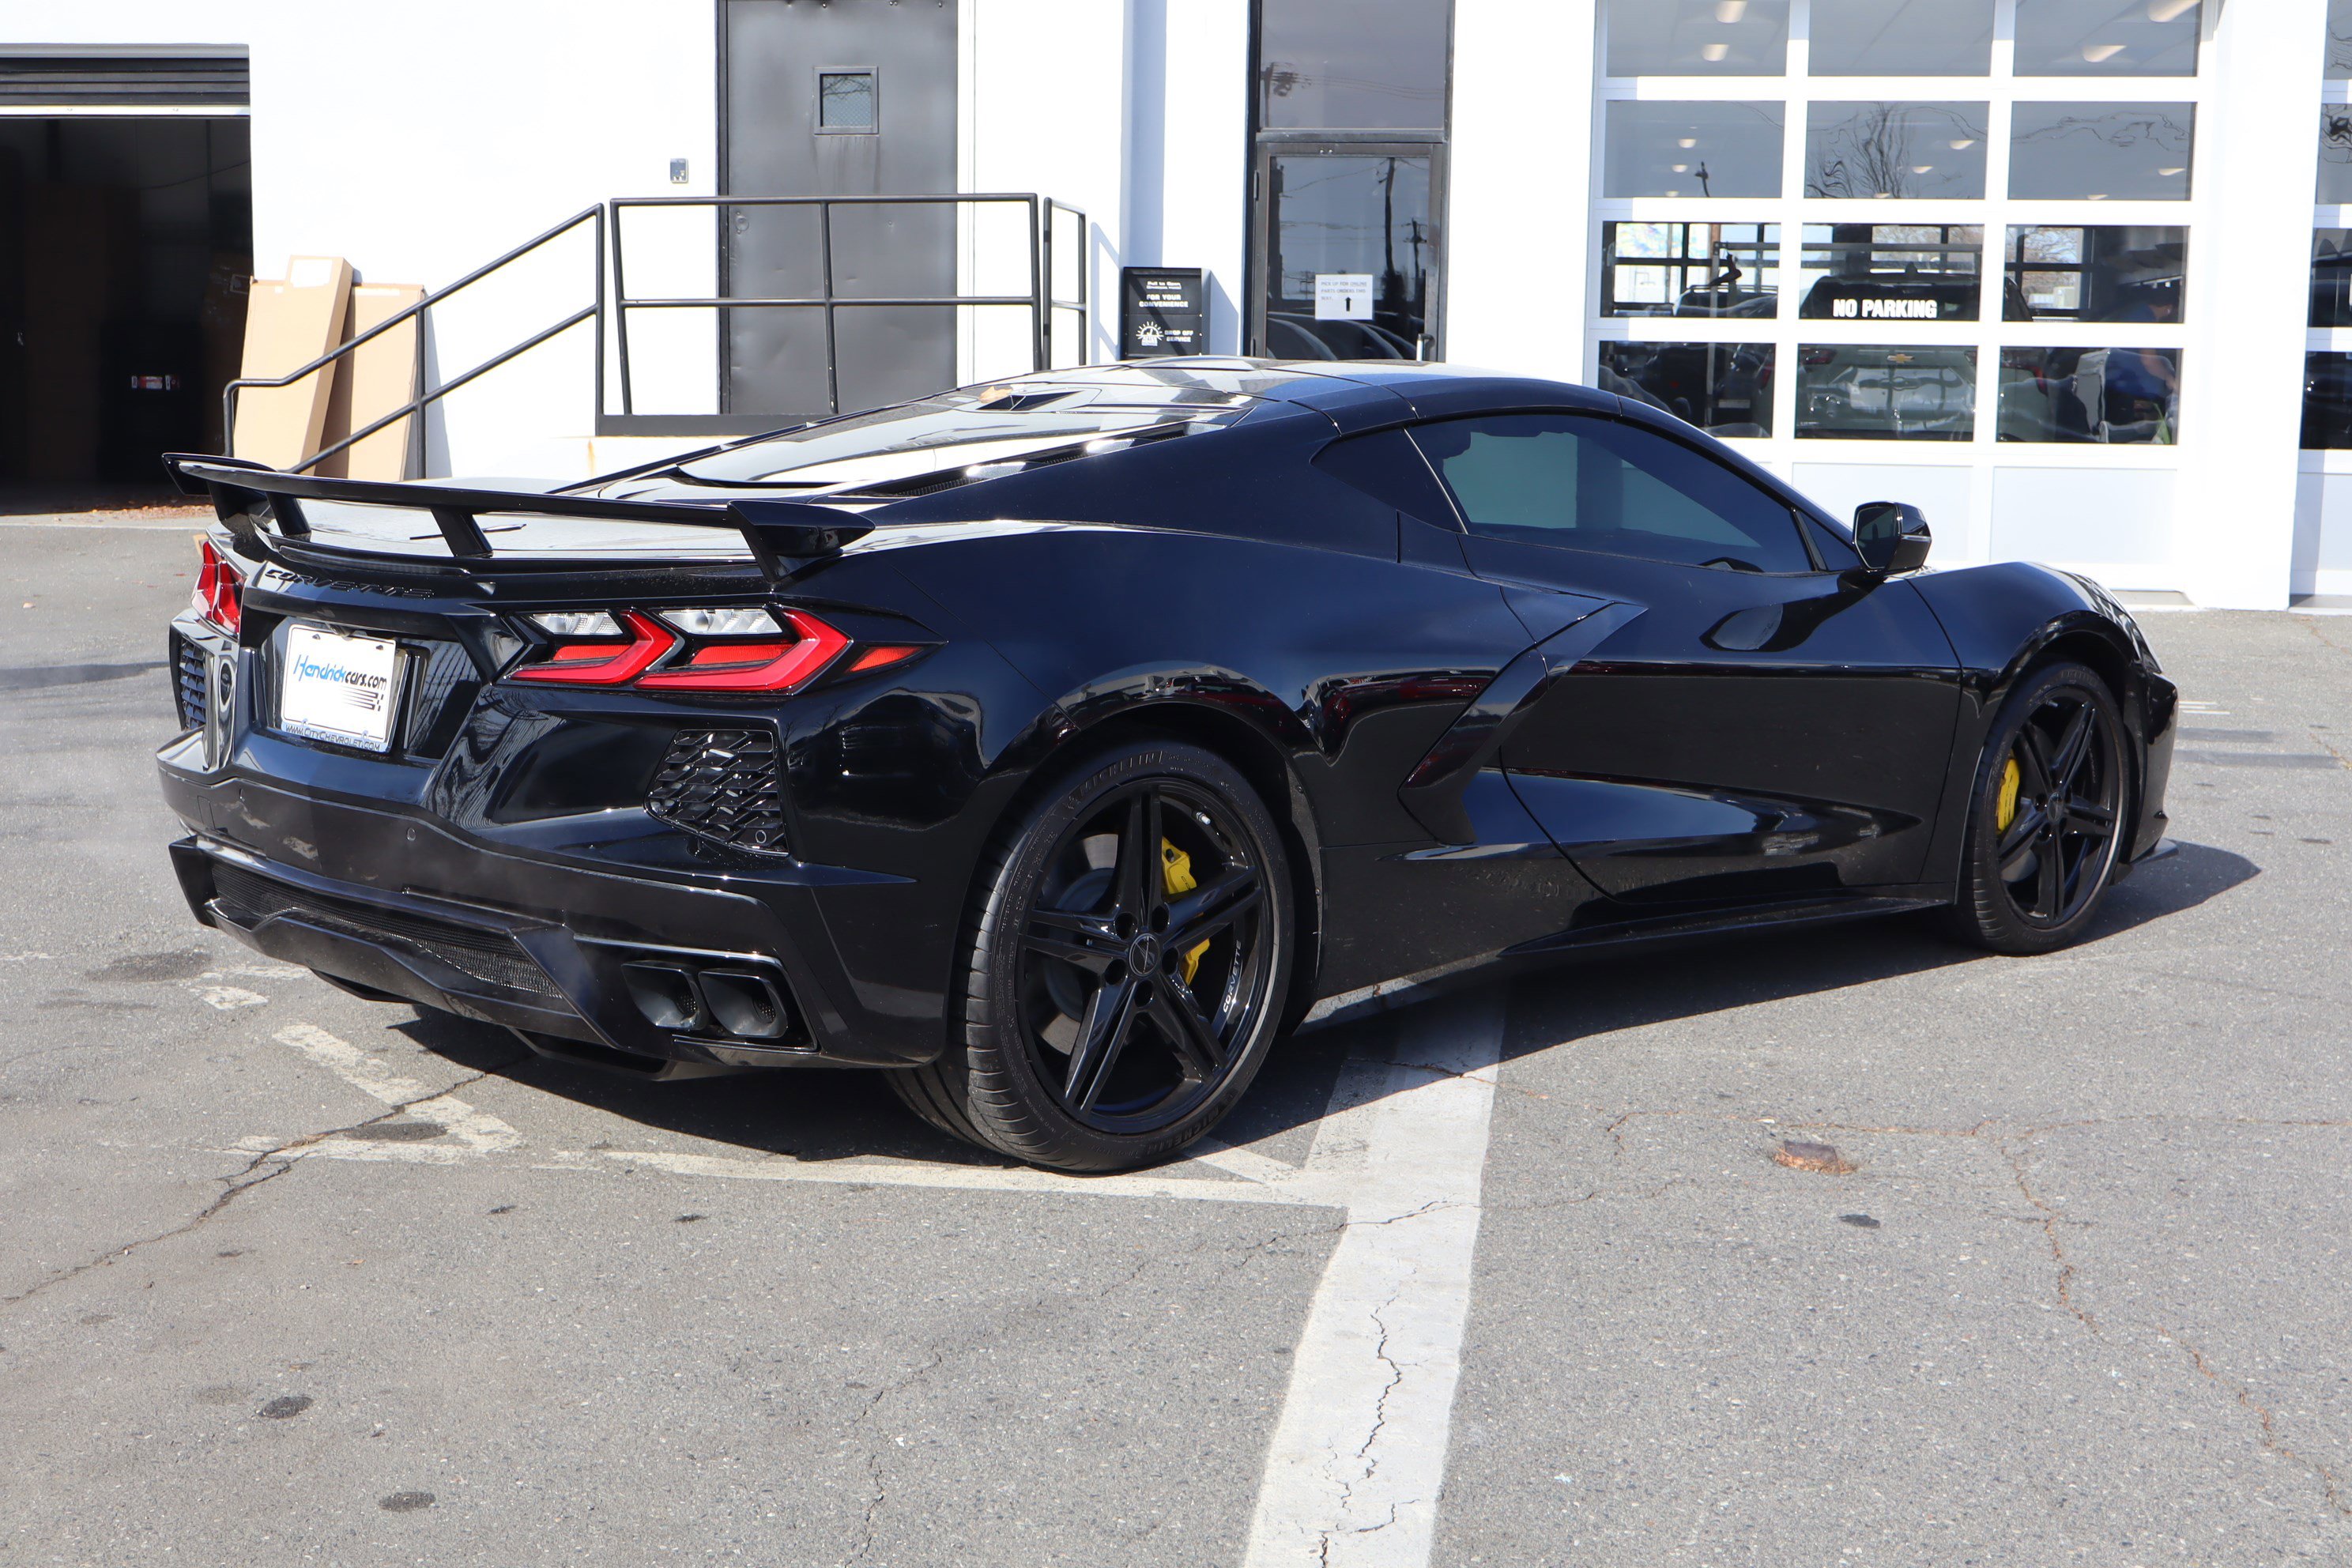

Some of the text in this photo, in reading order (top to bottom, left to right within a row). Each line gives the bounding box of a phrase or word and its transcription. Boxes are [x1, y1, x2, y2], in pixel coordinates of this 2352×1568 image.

[1833, 299, 1938, 318] NO PARKING
[264, 569, 434, 601] CORVETTE
[293, 654, 387, 691] Hendrickcars.com
[1223, 940, 1242, 1013] CORVETTE
